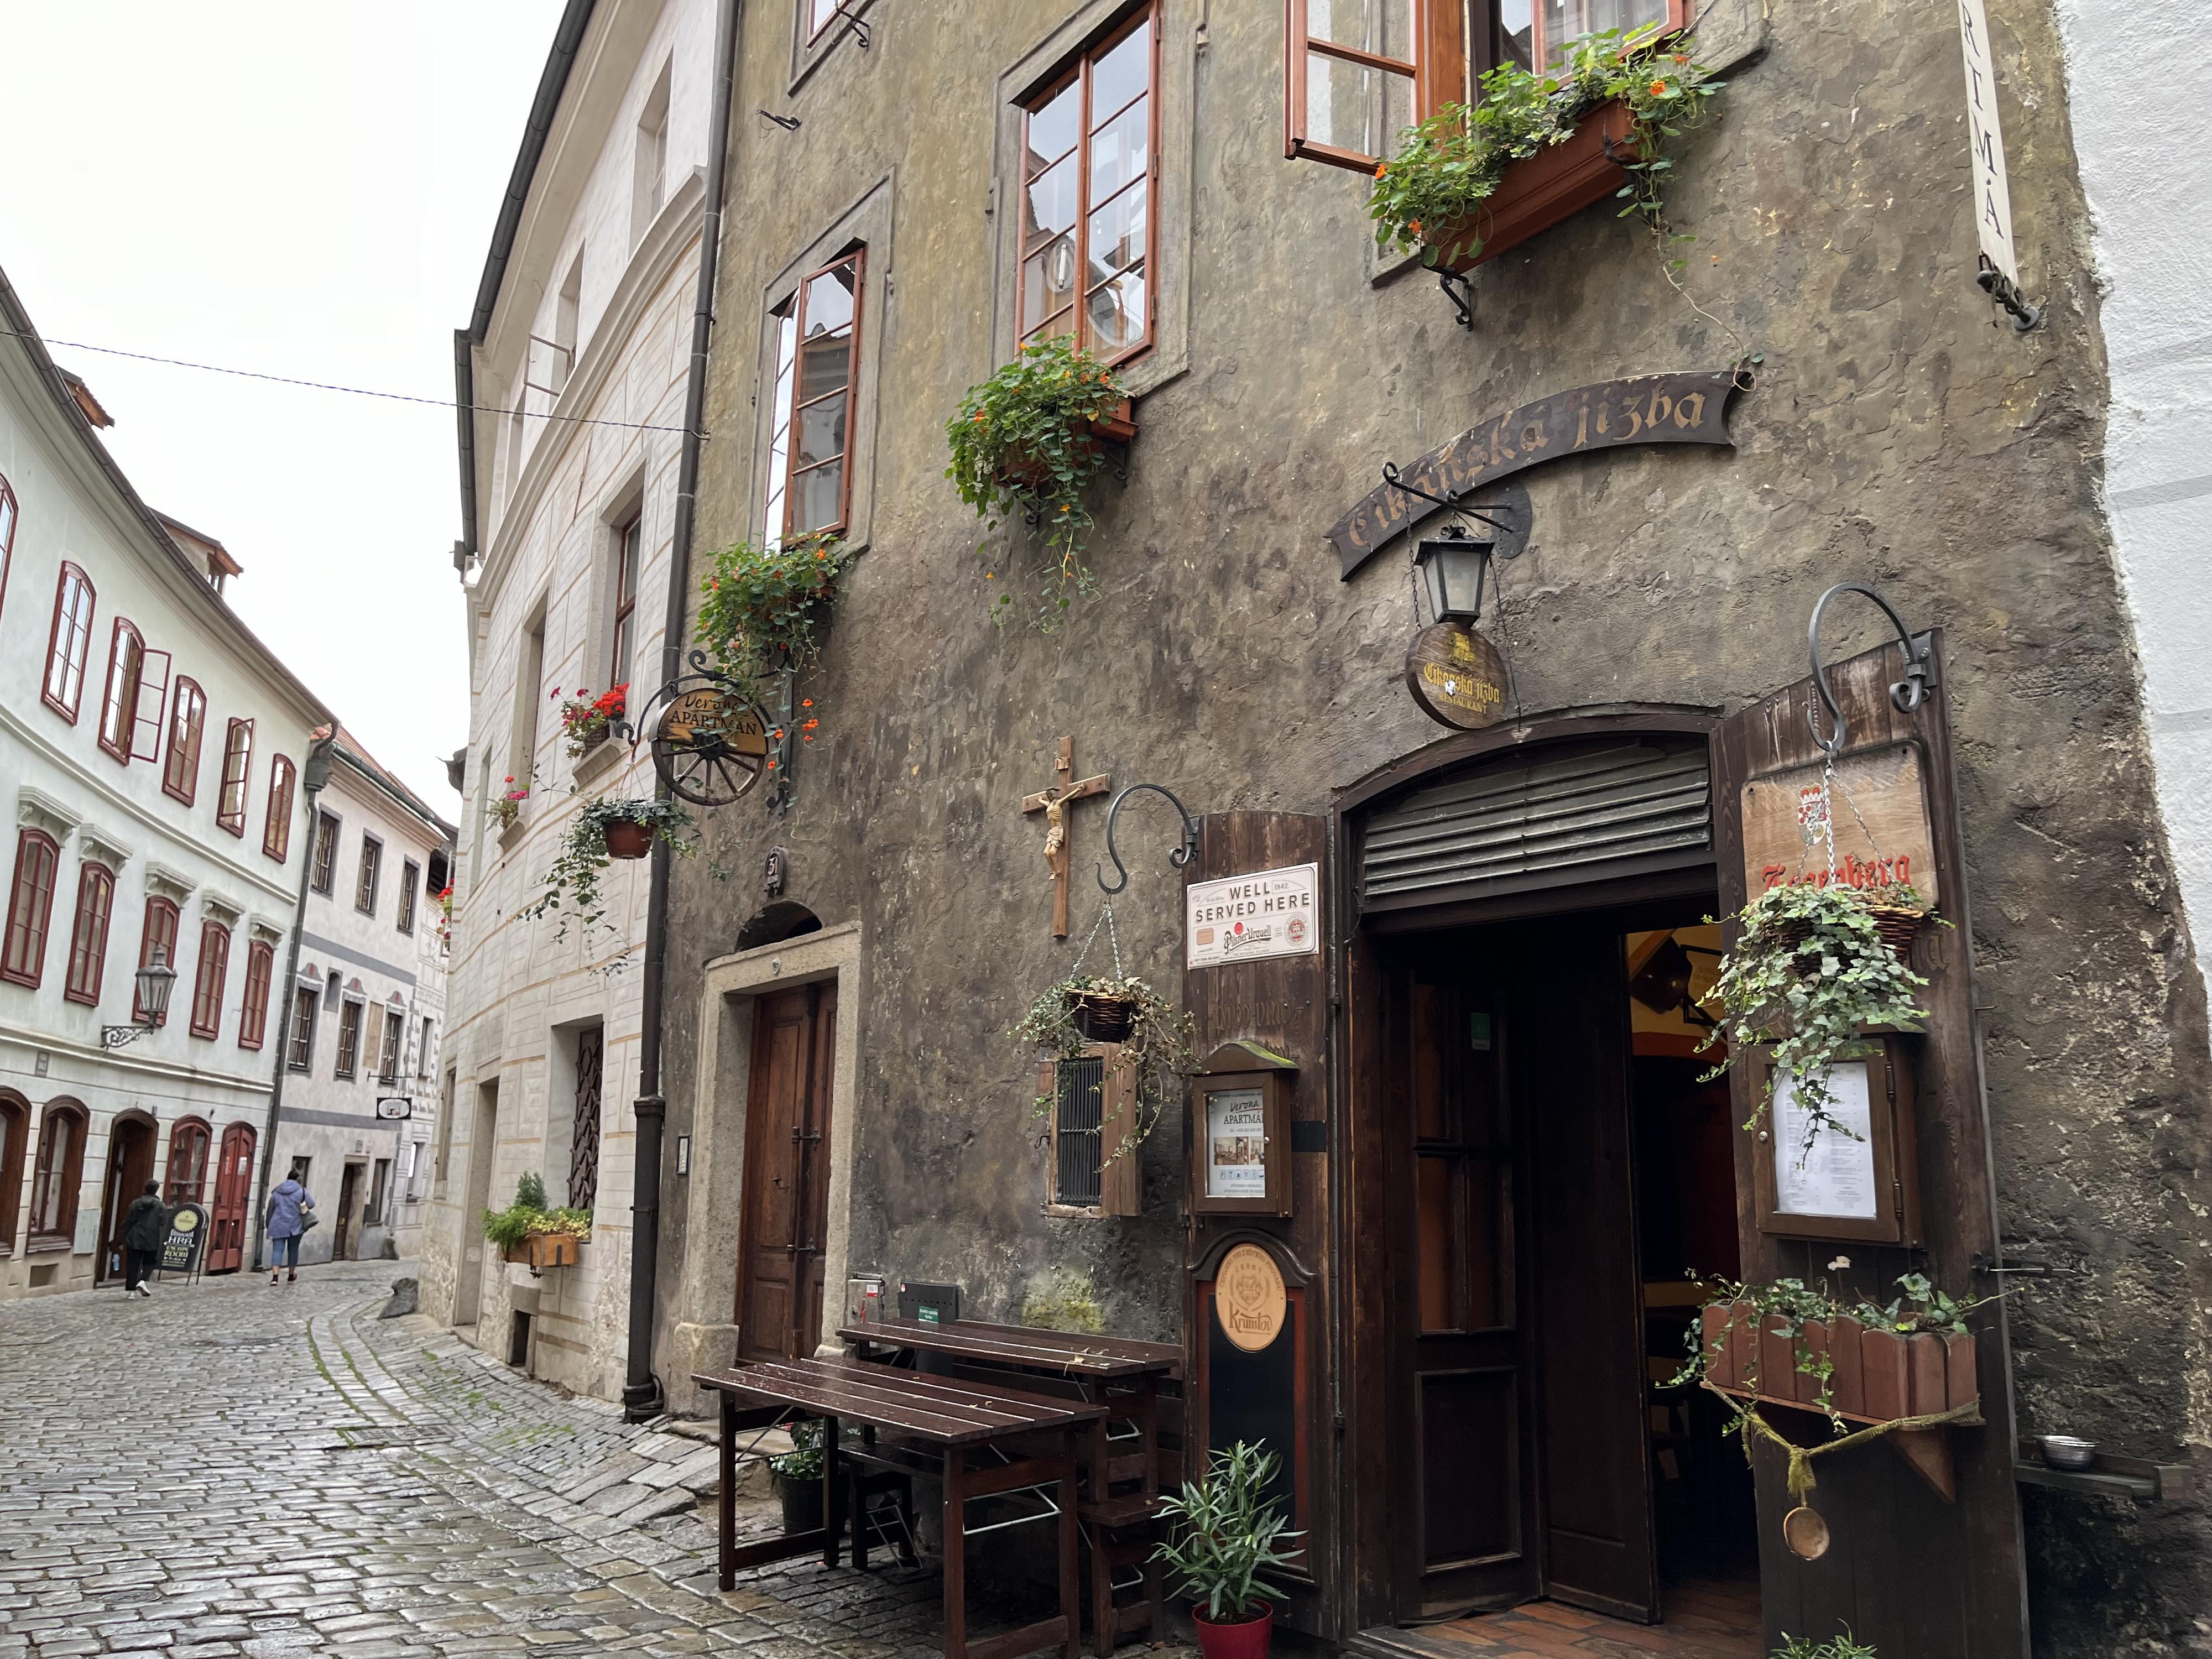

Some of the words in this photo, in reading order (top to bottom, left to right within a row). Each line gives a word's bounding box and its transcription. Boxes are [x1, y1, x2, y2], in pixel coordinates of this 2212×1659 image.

[1573, 386, 1707, 450] jizba
[1438, 691, 1488, 714] RESTAURANT
[768, 857, 779, 875] 31
[1229, 881, 1270, 900] WELL
[1274, 882, 1289, 890] 1842
[1196, 901, 1256, 922] SERVED
[1265, 893, 1310, 912] HERE
[1224, 930, 1248, 955] Pilsner
[1247, 924, 1272, 940] Urquell
[1229, 1099, 1260, 1113] Verona
[1223, 1111, 1264, 1124] APARTMÁ
[168, 1235, 192, 1245] HRA
[1228, 1298, 1272, 1333] Krumlov
